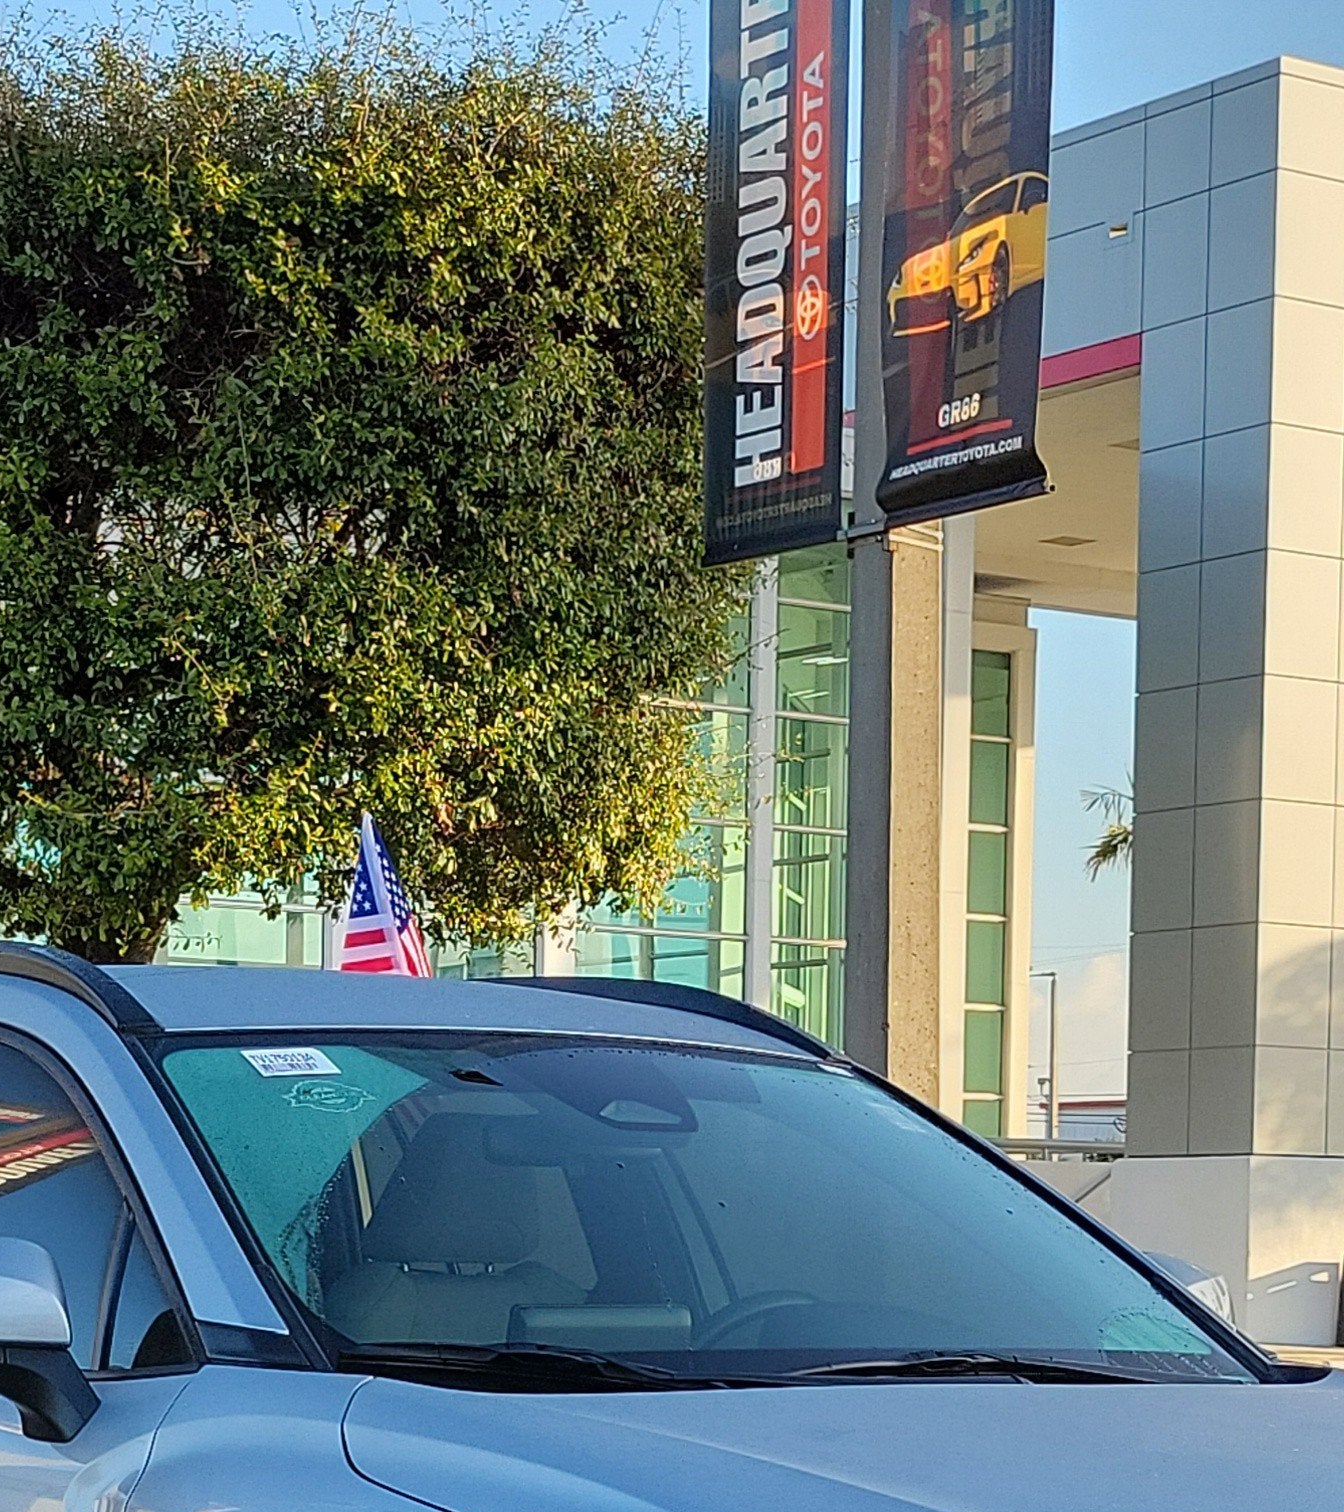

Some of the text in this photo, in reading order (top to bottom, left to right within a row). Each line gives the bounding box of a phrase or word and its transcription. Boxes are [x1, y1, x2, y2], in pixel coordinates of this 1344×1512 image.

[800, 50, 825, 265] TOYOTA
[937, 392, 981, 428] GR86
[888, 436, 1023, 481] HEADQUARTERTOYOTA.COM
